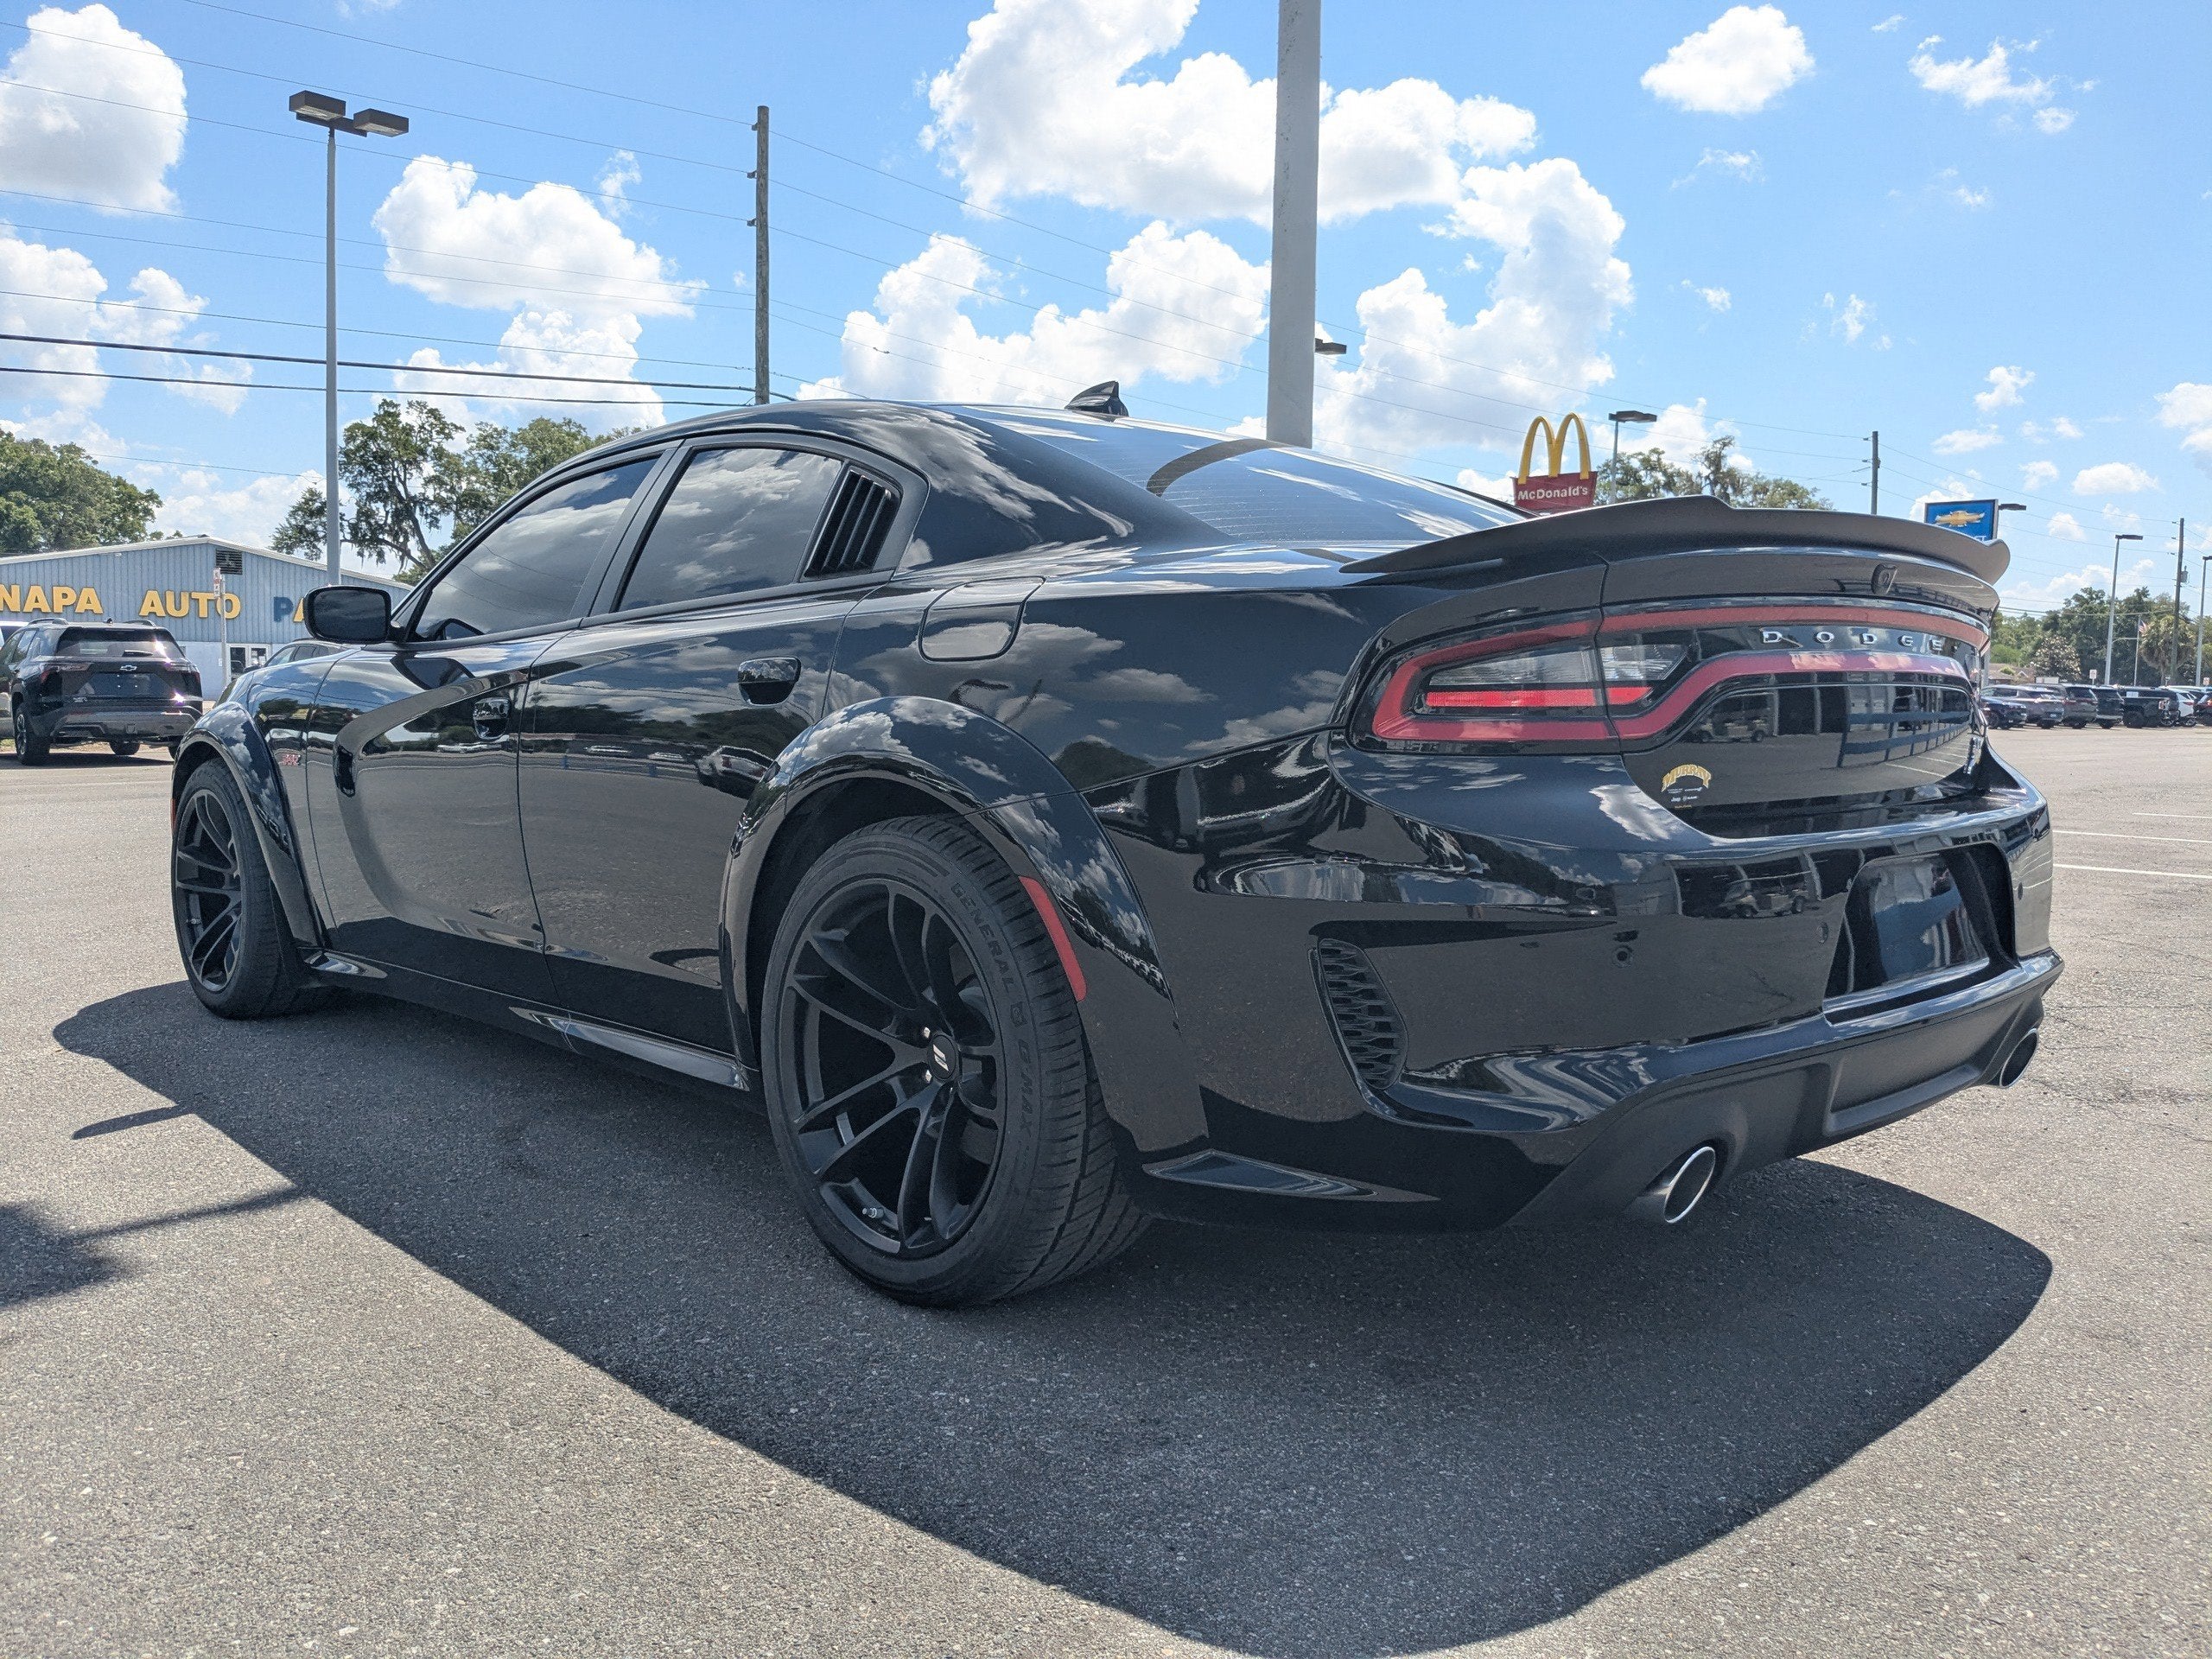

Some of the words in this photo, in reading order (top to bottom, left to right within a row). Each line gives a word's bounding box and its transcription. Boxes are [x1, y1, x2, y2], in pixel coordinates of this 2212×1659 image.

[1517, 486, 1588, 500] McDonald's
[0, 583, 104, 613] NAPA
[138, 589, 241, 620] AUTO
[1762, 631, 1944, 652] DODGE
[950, 881, 1015, 995] GENERAL
